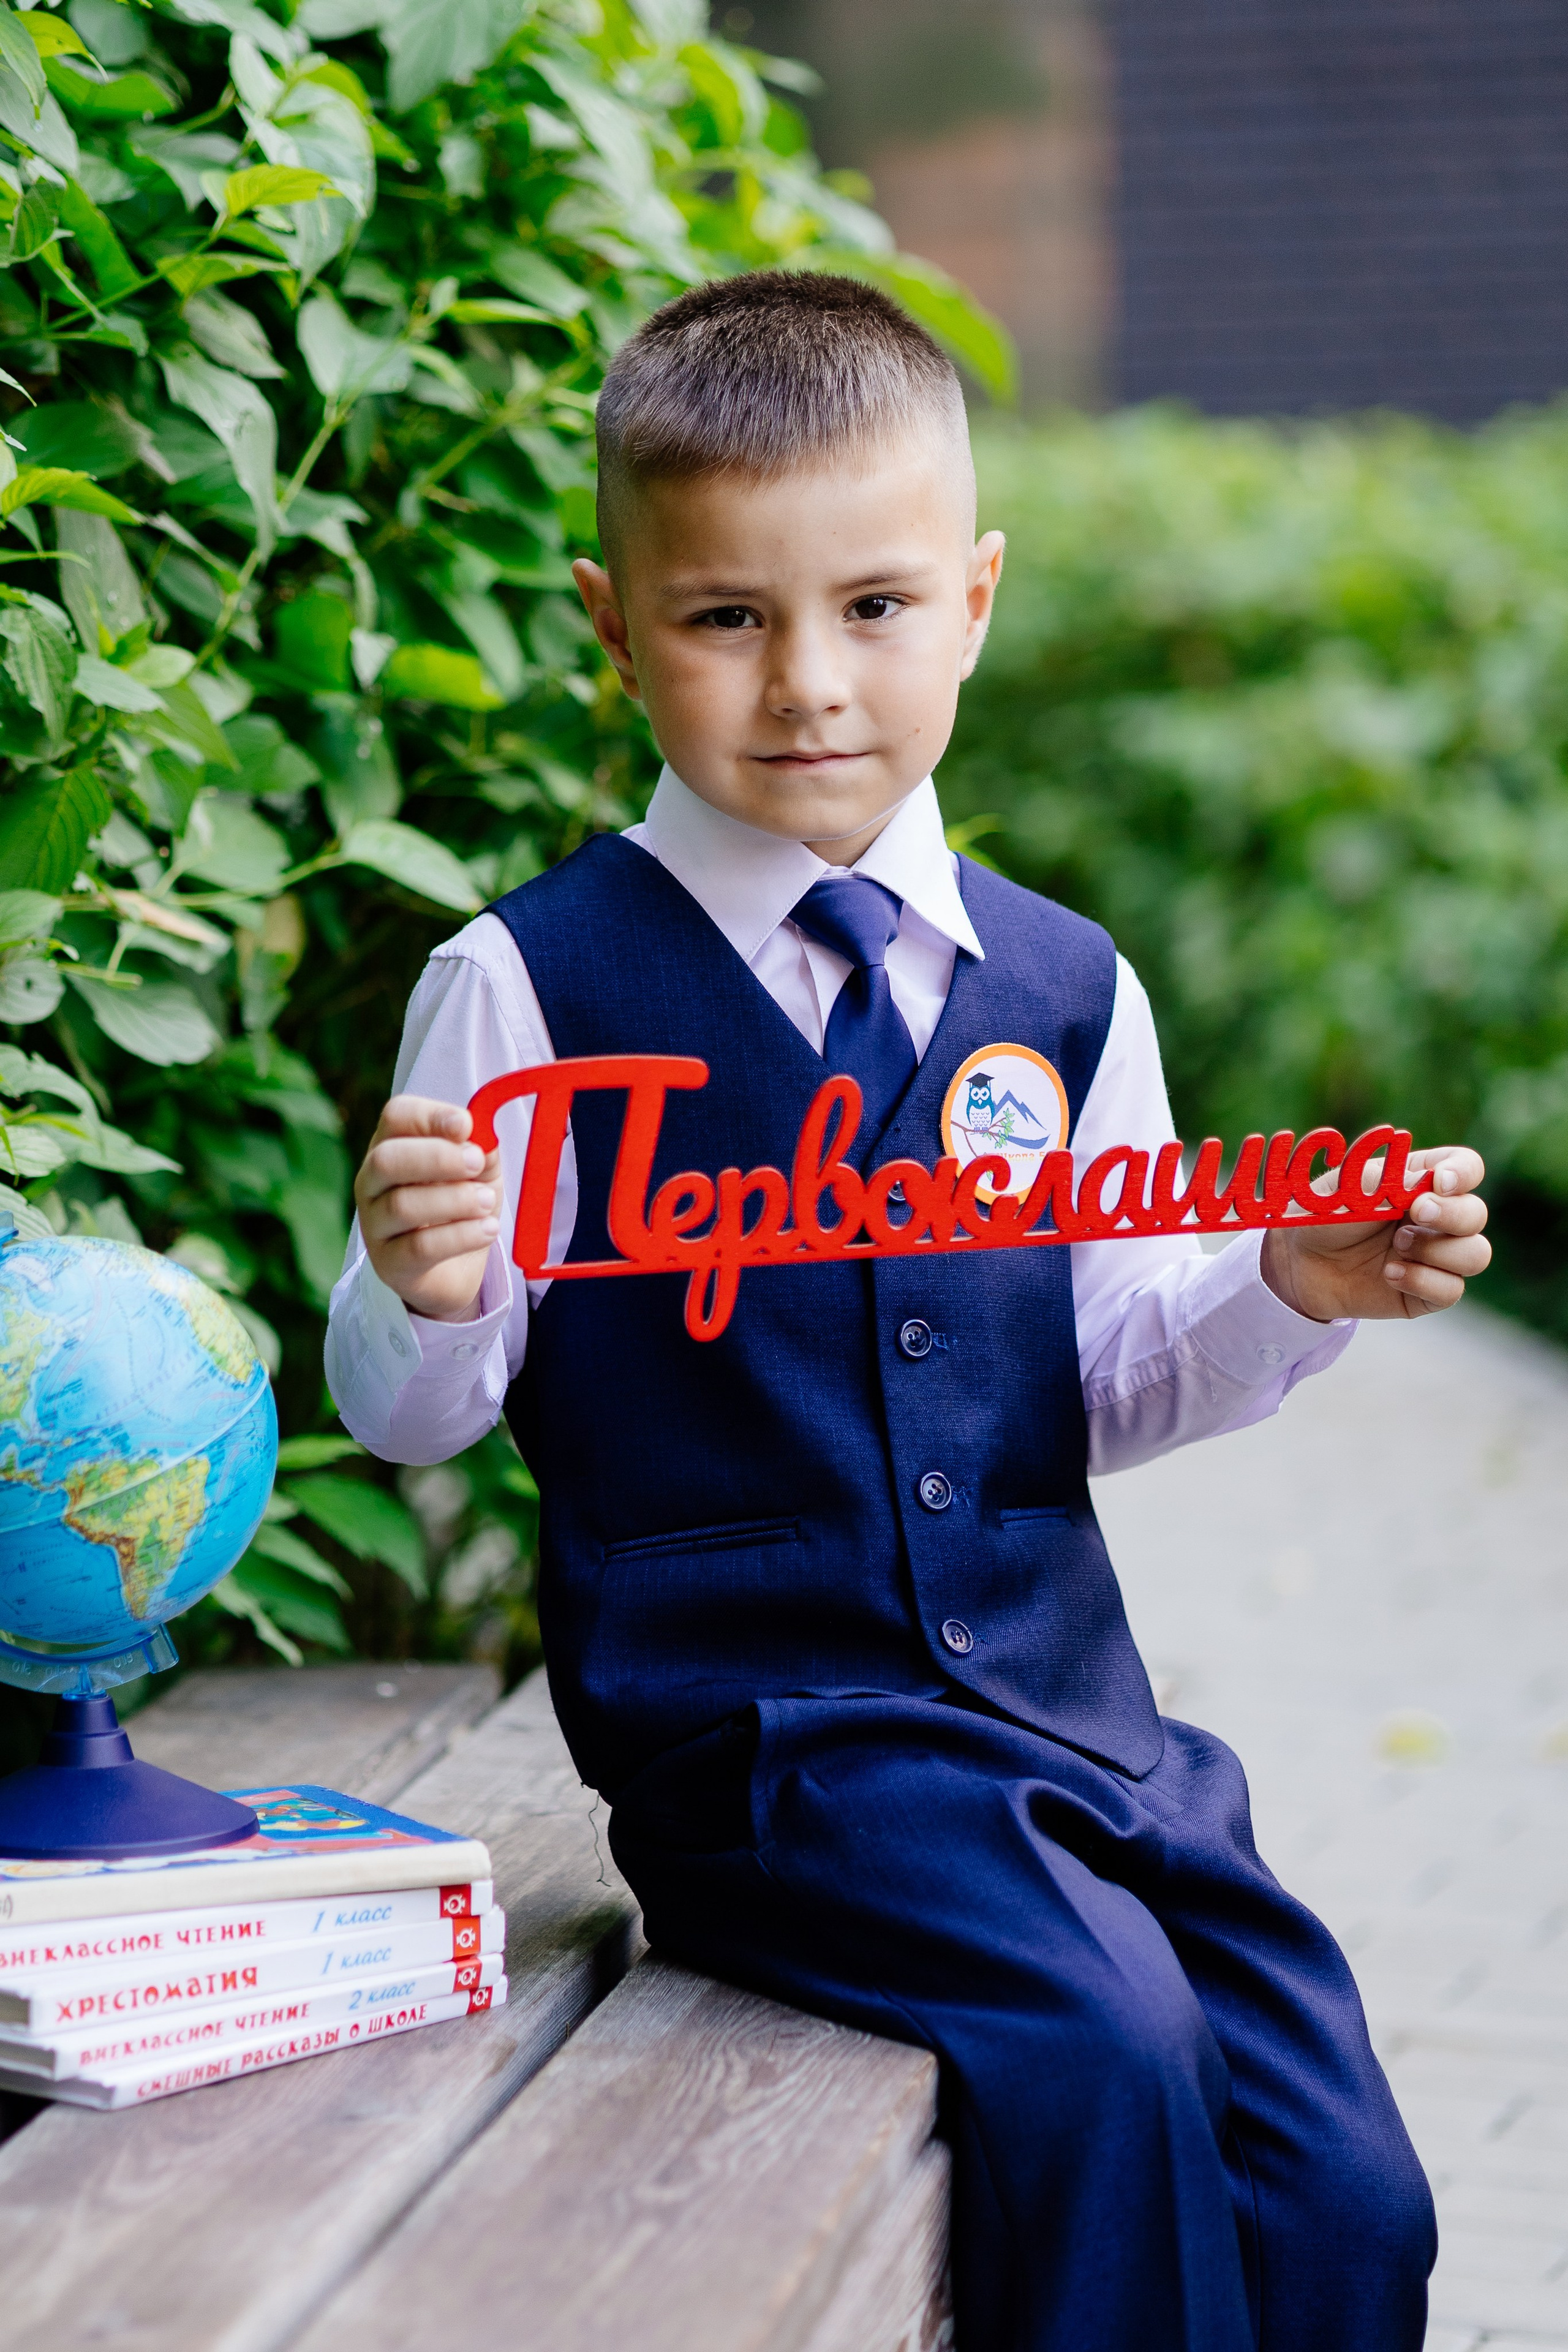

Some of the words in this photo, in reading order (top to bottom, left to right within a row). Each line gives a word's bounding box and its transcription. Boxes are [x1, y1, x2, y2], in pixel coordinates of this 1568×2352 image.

[467, 1054, 1434, 1342] Первоклашка
[176, 1920, 266, 1945] ЧТЕНИЕ
[312, 1910, 326, 1933] 1
[334, 1905, 393, 1928] класс
[56, 1966, 257, 2022] ХРЕСТОМАТИЯ
[320, 1951, 334, 1975] 1
[340, 1947, 392, 1970] класс
[79, 2021, 224, 2067] ВНЕКЛАССНОЕ
[235, 2002, 311, 2031] ЧТЕНИЕ
[348, 1989, 363, 2011] 2
[366, 1981, 417, 2004] класс
[137, 2058, 233, 2098] СМЕШНЫЕ
[241, 2027, 341, 2070] РАССКАЗЫ
[349, 2022, 360, 2039] О
[368, 2003, 428, 2035] ШКОЛЕ
